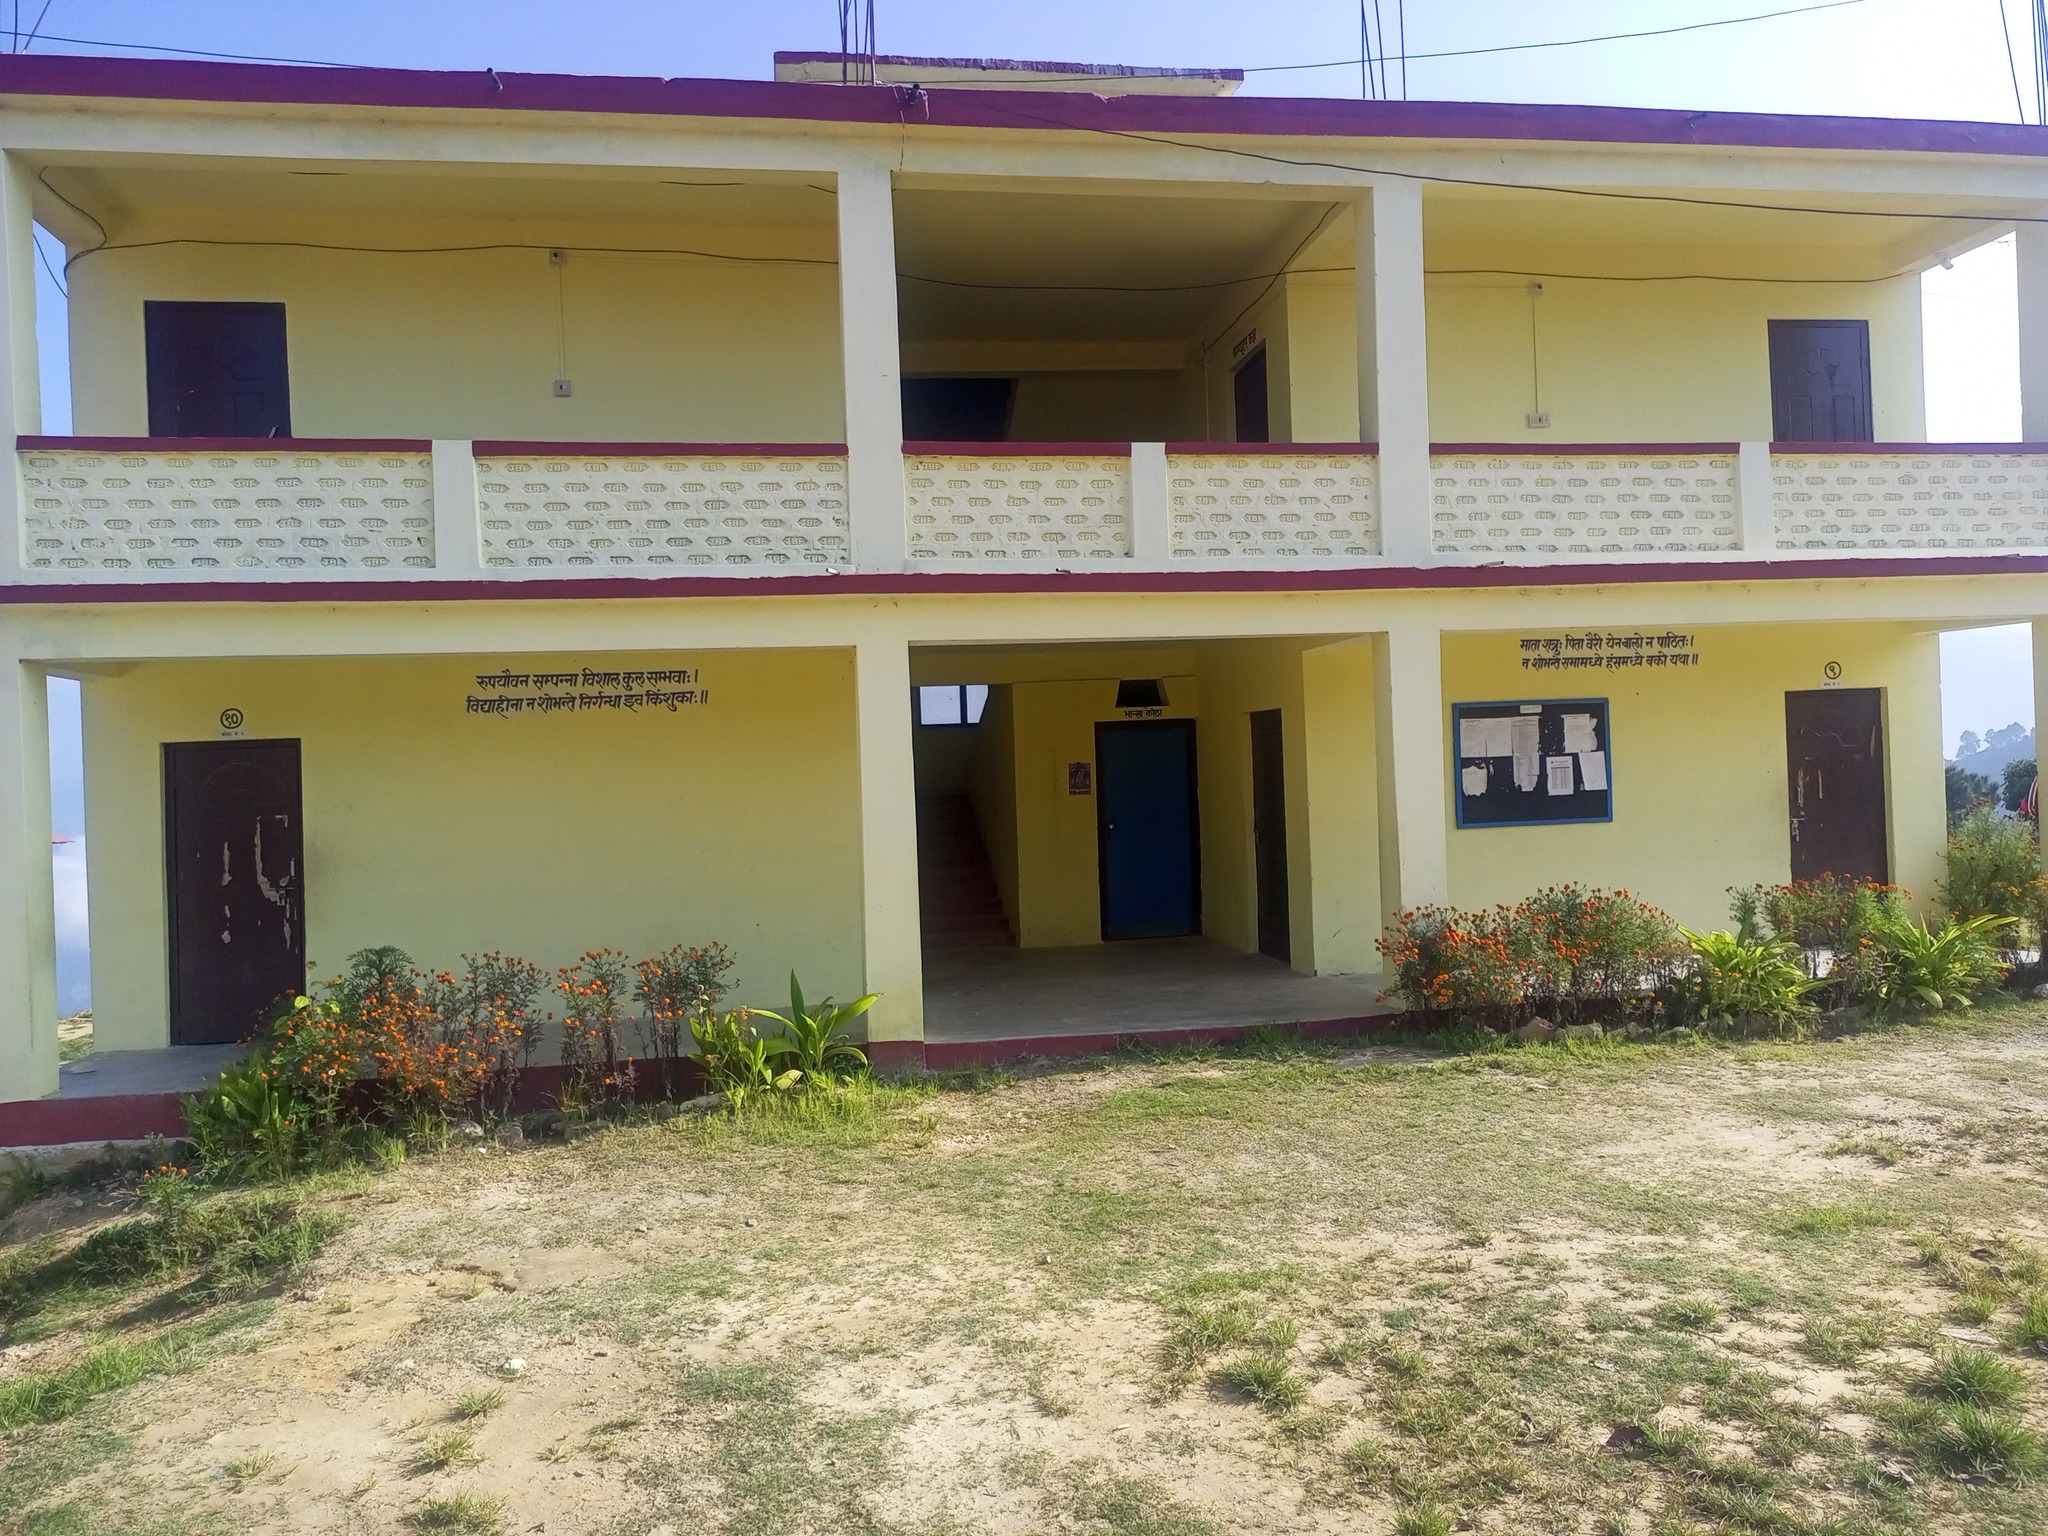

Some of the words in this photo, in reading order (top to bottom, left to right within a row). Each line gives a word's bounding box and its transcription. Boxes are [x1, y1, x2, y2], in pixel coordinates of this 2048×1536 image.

[106, 480, 126, 488] JBF
[149, 480, 170, 488] JBF
[192, 480, 212, 488] JBF
[235, 480, 255, 488] JBF
[278, 479, 298, 488] JBF
[320, 479, 341, 488] JBF
[363, 479, 383, 488] JBF
[405, 480, 425, 489] JBF
[948, 481, 967, 489] JBF
[1056, 481, 1074, 489] JBF
[1173, 480, 1191, 488] JBF
[1314, 479, 1332, 487] JBF
[566, 484, 586, 493] JBF
[605, 484, 625, 493] JBF
[644, 485, 664, 493] JBF
[682, 485, 702, 493] JBF
[721, 483, 741, 492] JBF
[759, 484, 779, 492] JBF
[796, 483, 816, 492] JBF
[300, 499, 320, 508] JBF
[343, 499, 363, 508] JBF
[384, 500, 405, 508] JBF
[932, 498, 950, 507] JBF
[969, 499, 988, 507] JBF
[1045, 499, 1063, 507] JBF
[1082, 499, 1101, 507] JBF
[1196, 497, 1213, 505] JBF
[1332, 496, 1349, 504] JBF
[37, 500, 57, 509] JBF
[84, 500, 105, 509] JBF
[129, 501, 150, 509] JBF
[173, 501, 193, 510] JBF
[215, 500, 236, 509] JBF
[257, 500, 278, 509] JBF
[506, 504, 526, 512] JBF
[546, 504, 566, 512] JBF
[587, 503, 607, 511] JBF
[666, 503, 686, 511] JBF
[705, 502, 725, 510] JBF
[745, 501, 765, 510] JBF
[783, 501, 803, 509] JBF
[914, 517, 932, 525] JBF
[952, 517, 970, 525] JBF
[1210, 515, 1228, 523] JBF
[1245, 515, 1263, 523] JBF
[1280, 515, 1297, 523] JBF
[1314, 514, 1332, 522] JBF
[1350, 513, 1367, 521] JBF
[108, 521, 128, 529] JBF
[151, 520, 172, 529] JBF
[194, 520, 215, 529] JBF
[237, 520, 257, 529] JBF
[321, 520, 341, 528] JBF
[487, 522, 507, 530] JBF
[528, 523, 548, 531] JBF
[568, 522, 588, 530] JBF
[608, 522, 628, 530] JBF
[647, 521, 667, 529] JBF
[685, 520, 705, 528] JBF
[725, 519, 745, 528] JBF
[799, 519, 819, 528] JBF
[936, 534, 954, 542] JBF
[971, 534, 989, 542] JBF
[1078, 533, 1097, 541] JBF
[1195, 532, 1213, 540] JBF
[1263, 532, 1281, 540] JBF
[1330, 531, 1348, 539] JBF
[38, 540, 59, 549] JBF
[130, 540, 150, 549] JBF
[174, 539, 195, 548] JBF
[218, 540, 238, 548] JBF
[260, 539, 281, 548] JBF
[303, 539, 323, 548] JBF
[345, 538, 365, 547] JBF
[387, 539, 408, 548] JBF
[550, 540, 570, 549] JBF
[630, 539, 650, 548] JBF
[668, 539, 688, 547] JBF
[708, 538, 728, 546] JBF
[747, 538, 767, 546] JBF
[280, 558, 300, 567] JBF
[322, 558, 343, 567] JBF
[365, 558, 385, 567] JBF
[529, 559, 549, 567] JBF
[569, 558, 589, 566] JBF
[728, 556, 748, 565] JBF
[766, 555, 786, 563] JBF
[804, 555, 824, 563] JBF
[106, 560, 126, 569] JBF
[1520, 638, 1542, 653] माता
[1564, 633, 1585, 652] पिता
[1585, 631, 1604, 651] वैरी
[1645, 636, 1655, 648] न
[1522, 658, 1531, 670] न
[1531, 654, 1562, 672] शोभन्ते
[1606, 652, 1644, 674] हंसमध्ये
[532, 672, 579, 690] सम्पन्ना
[581, 667, 621, 689] विशाल
[622, 671, 645, 691] कुल
[466, 695, 524, 719] विद्याहीना
[526, 697, 537, 711] न
[537, 692, 577, 714] शोभन्ते
[579, 691, 622, 711] निर्गन्धा
[623, 694, 644, 713] इव
